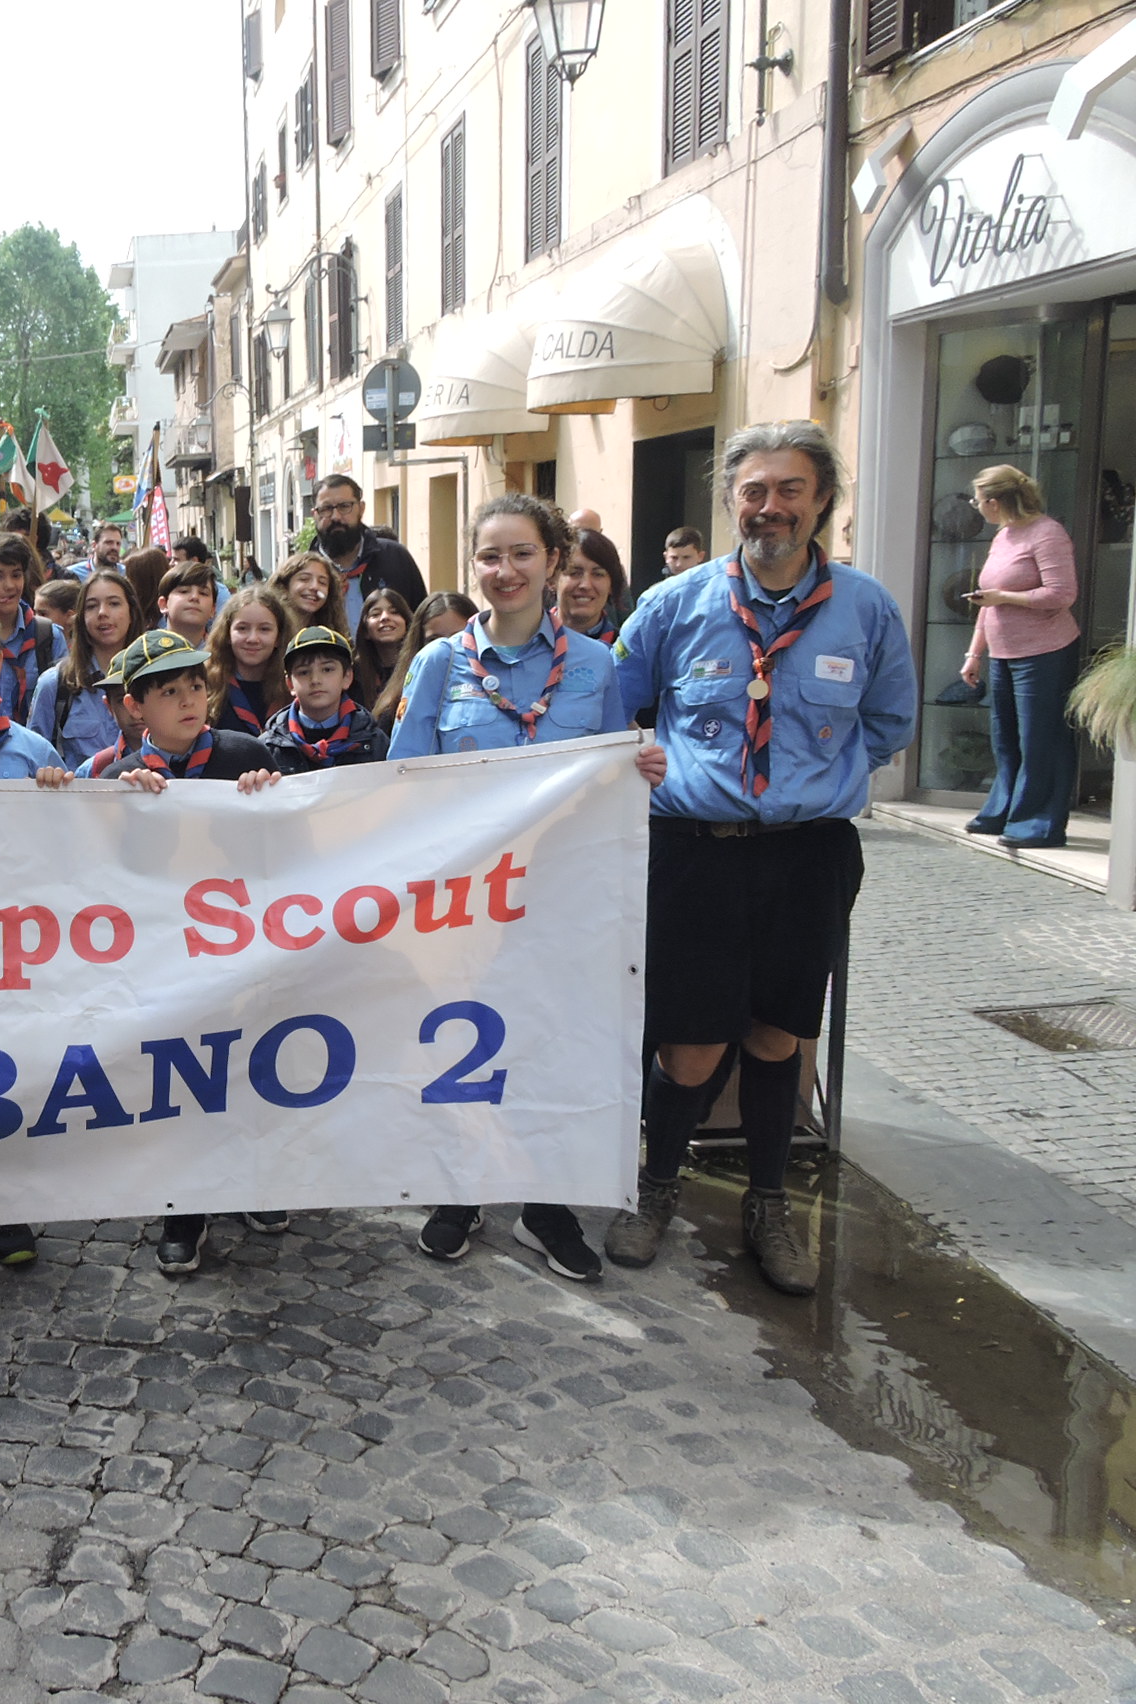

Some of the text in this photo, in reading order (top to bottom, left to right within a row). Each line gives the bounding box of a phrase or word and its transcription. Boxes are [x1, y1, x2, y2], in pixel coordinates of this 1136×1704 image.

[919, 153, 1051, 287] Violia
[542, 330, 615, 361] CALDA
[183, 851, 527, 958] Scout
[418, 1000, 508, 1105] 2
